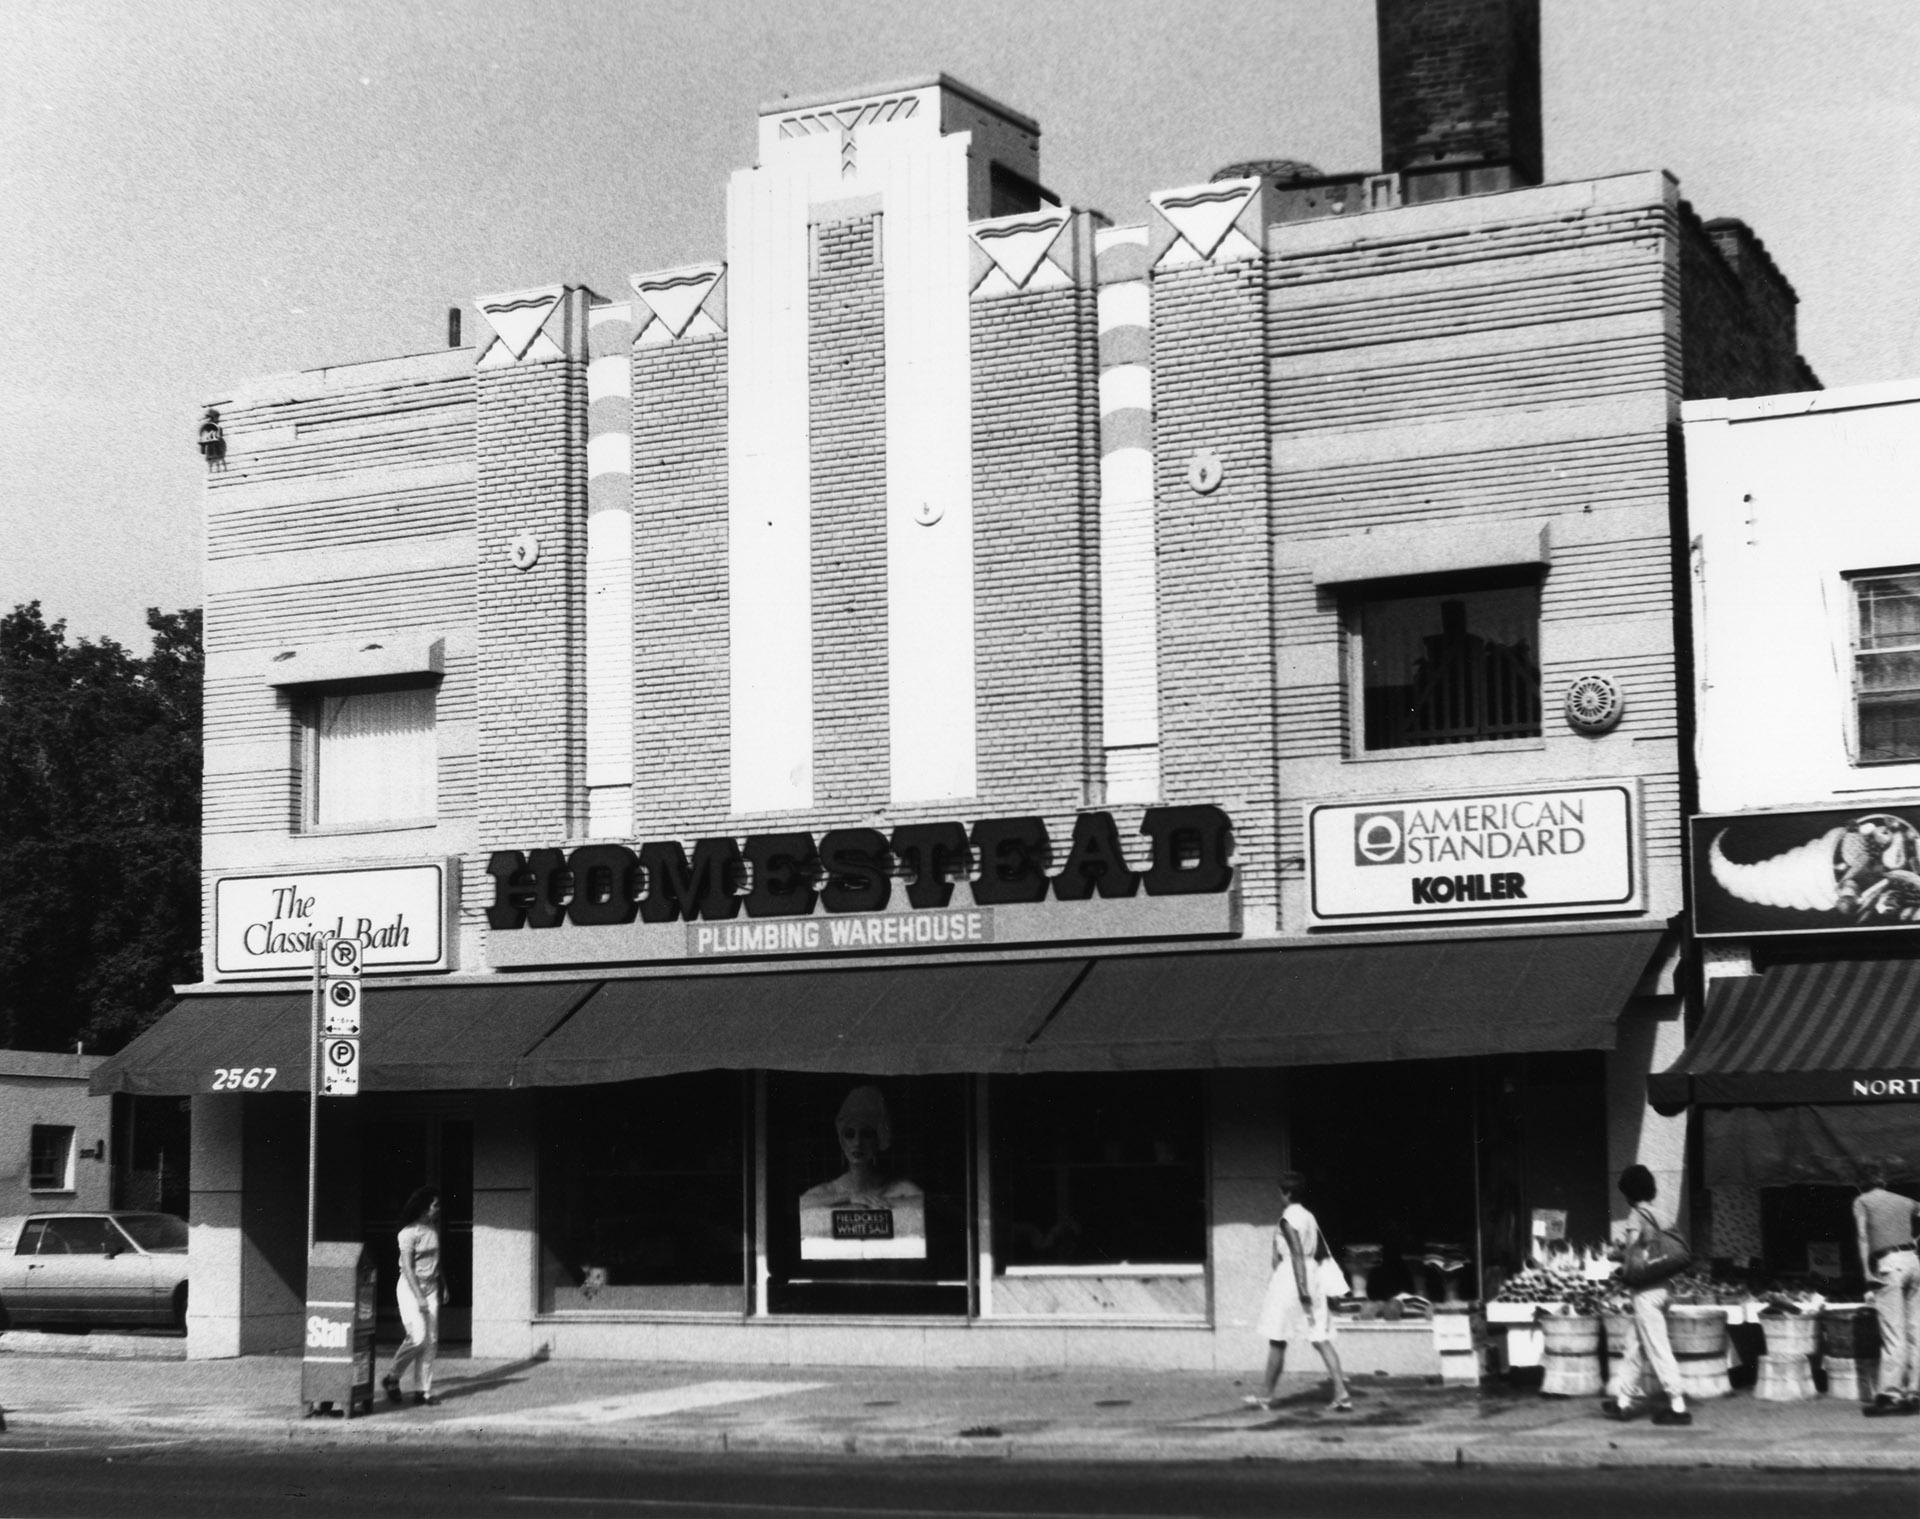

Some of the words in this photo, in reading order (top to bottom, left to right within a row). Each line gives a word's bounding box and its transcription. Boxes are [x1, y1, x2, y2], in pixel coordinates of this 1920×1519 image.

[1407, 799, 1585, 835] AMERICAN
[1408, 827, 1586, 864] STANDARD
[485, 804, 1235, 930] HOMESTEAD
[271, 885, 316, 920] The
[1412, 872, 1528, 905] KOHLER
[356, 913, 410, 950] Bath
[698, 921, 819, 953] PLUMBING
[830, 912, 982, 947] WAREHOUSE
[212, 1067, 277, 1090] 2567
[1852, 1078, 1920, 1096] NORT
[307, 1315, 352, 1348] Star
